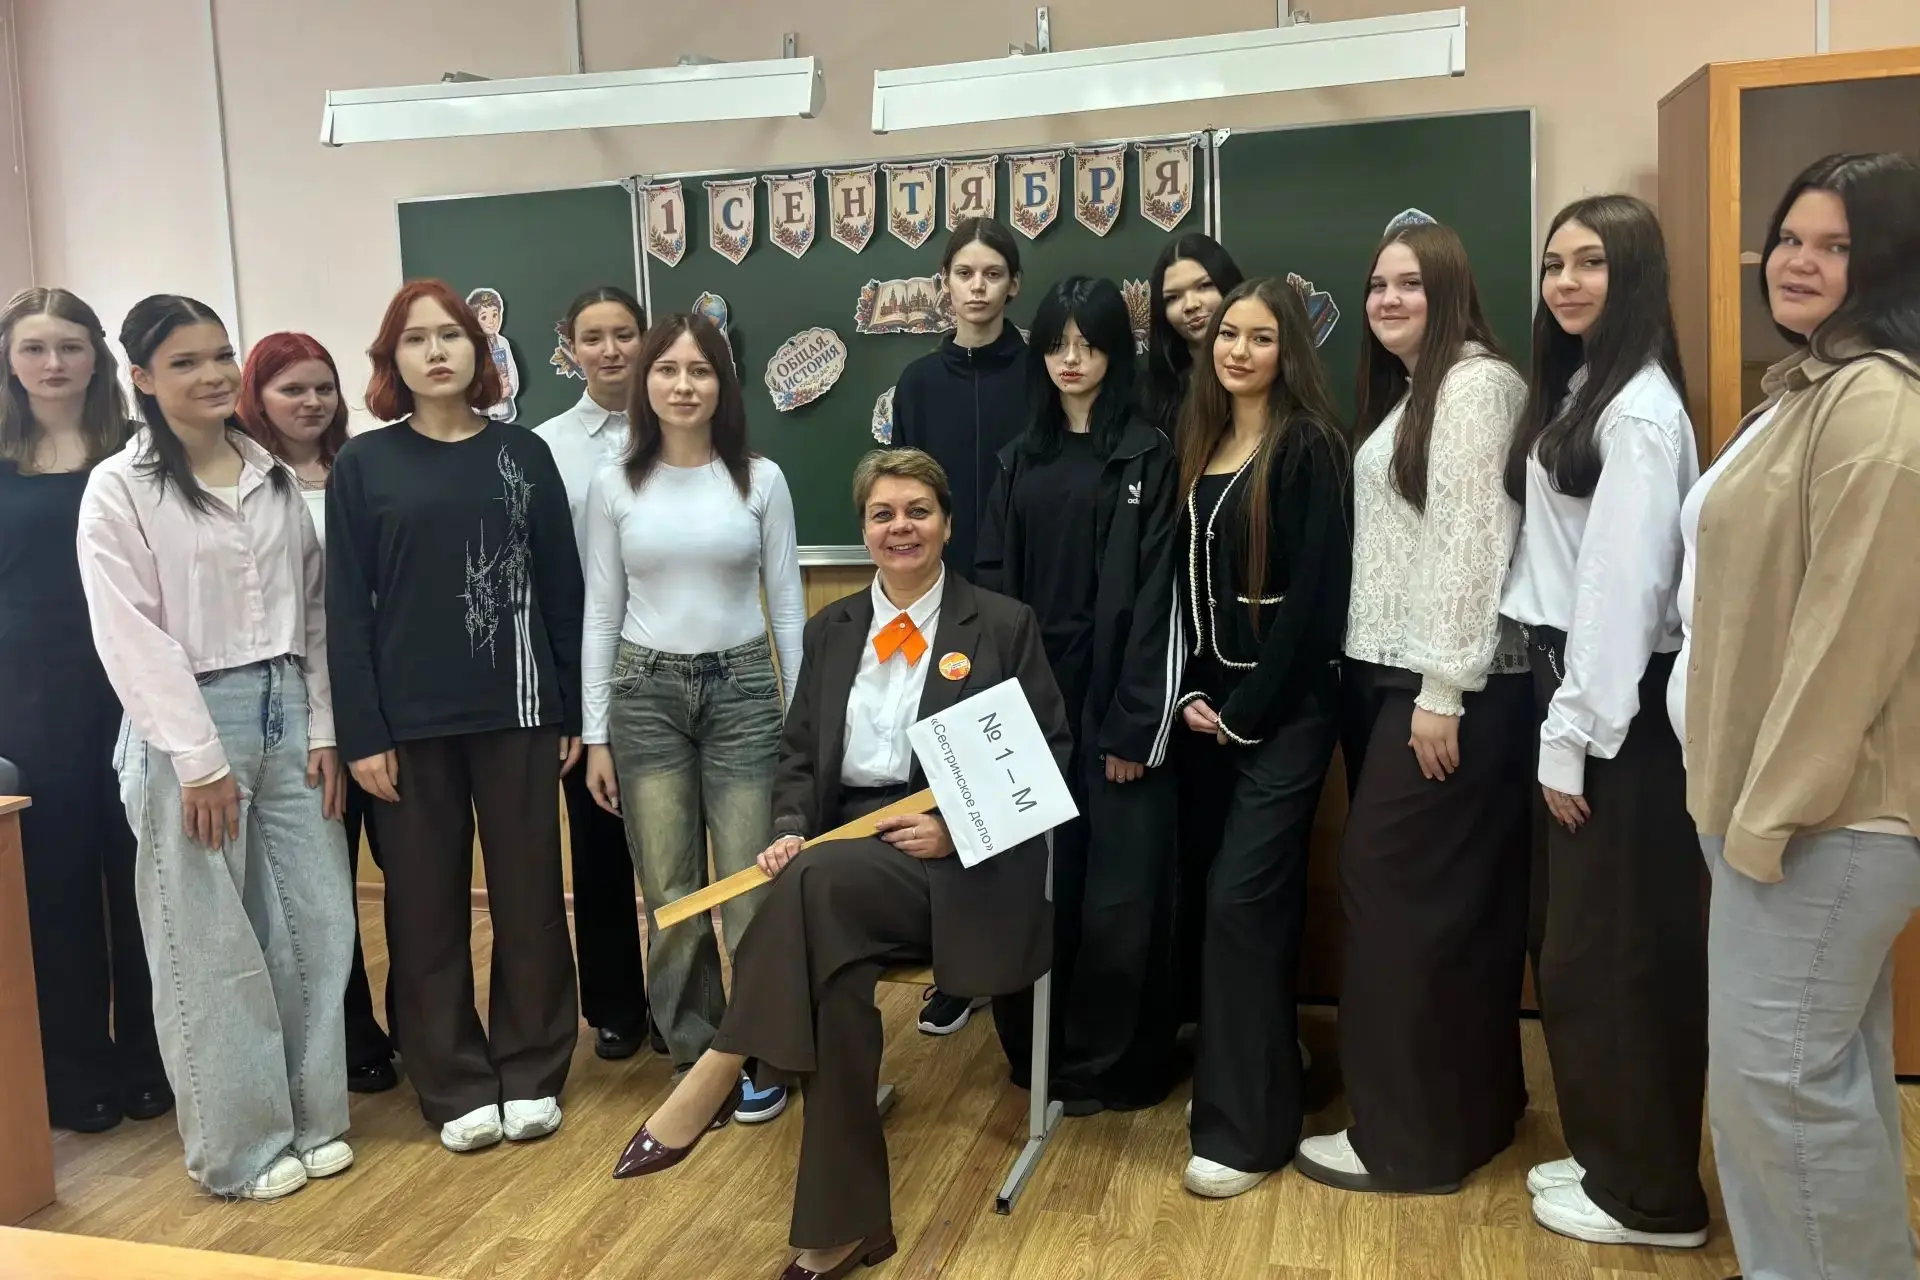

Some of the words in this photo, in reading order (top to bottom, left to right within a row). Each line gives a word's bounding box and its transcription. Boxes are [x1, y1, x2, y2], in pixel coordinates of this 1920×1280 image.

[660, 198, 678, 235] 1
[721, 159, 1182, 232] СЕНТЯБРЯ
[776, 335, 830, 378] ОБЩАЯ
[782, 343, 841, 391] ИСТОРИЯ
[930, 717, 976, 809] «Сестринское
[967, 810, 995, 852] дело»
[977, 711, 1003, 744] №
[995, 747, 1015, 762] 1
[1011, 786, 1038, 814] М
